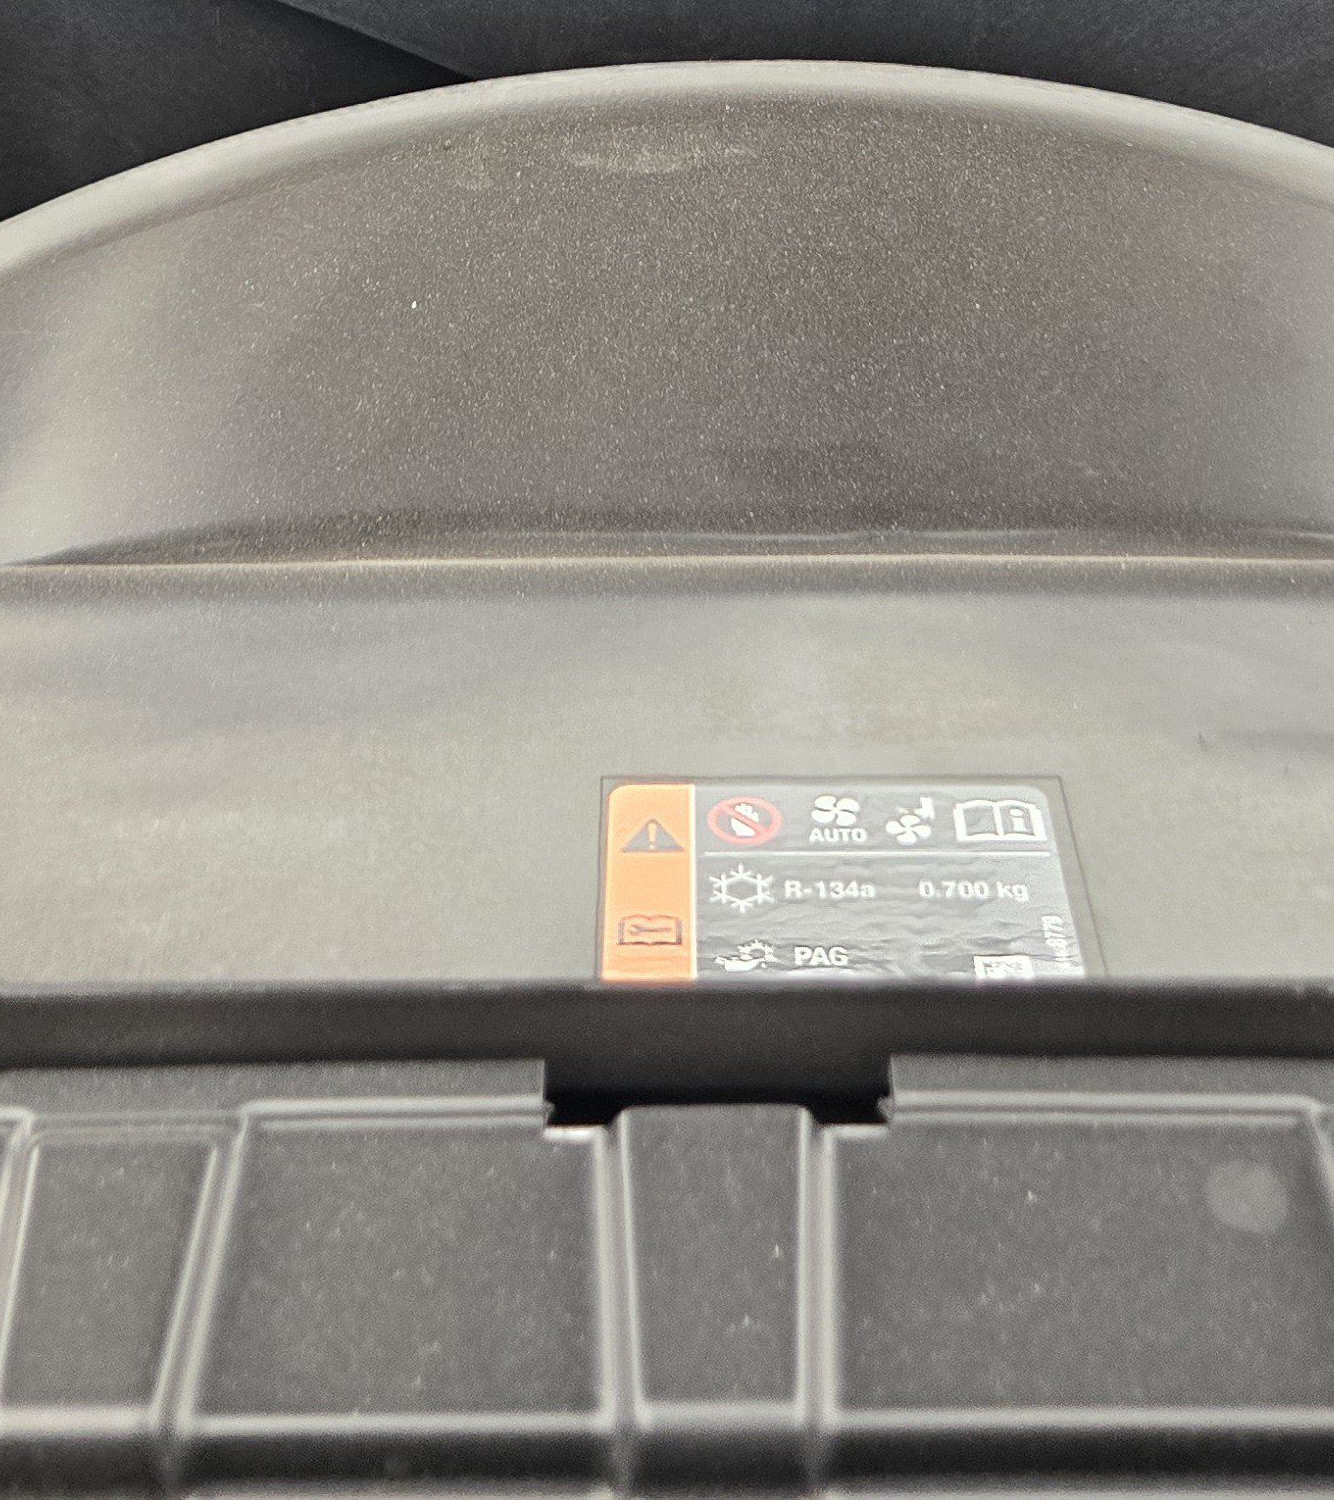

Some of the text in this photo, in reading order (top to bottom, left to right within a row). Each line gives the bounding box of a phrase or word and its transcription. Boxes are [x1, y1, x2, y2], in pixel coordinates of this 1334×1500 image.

[809, 827, 867, 844] AUTO
[784, 880, 1029, 901] R-134a 0.700 kg
[794, 946, 850, 967] PAG
